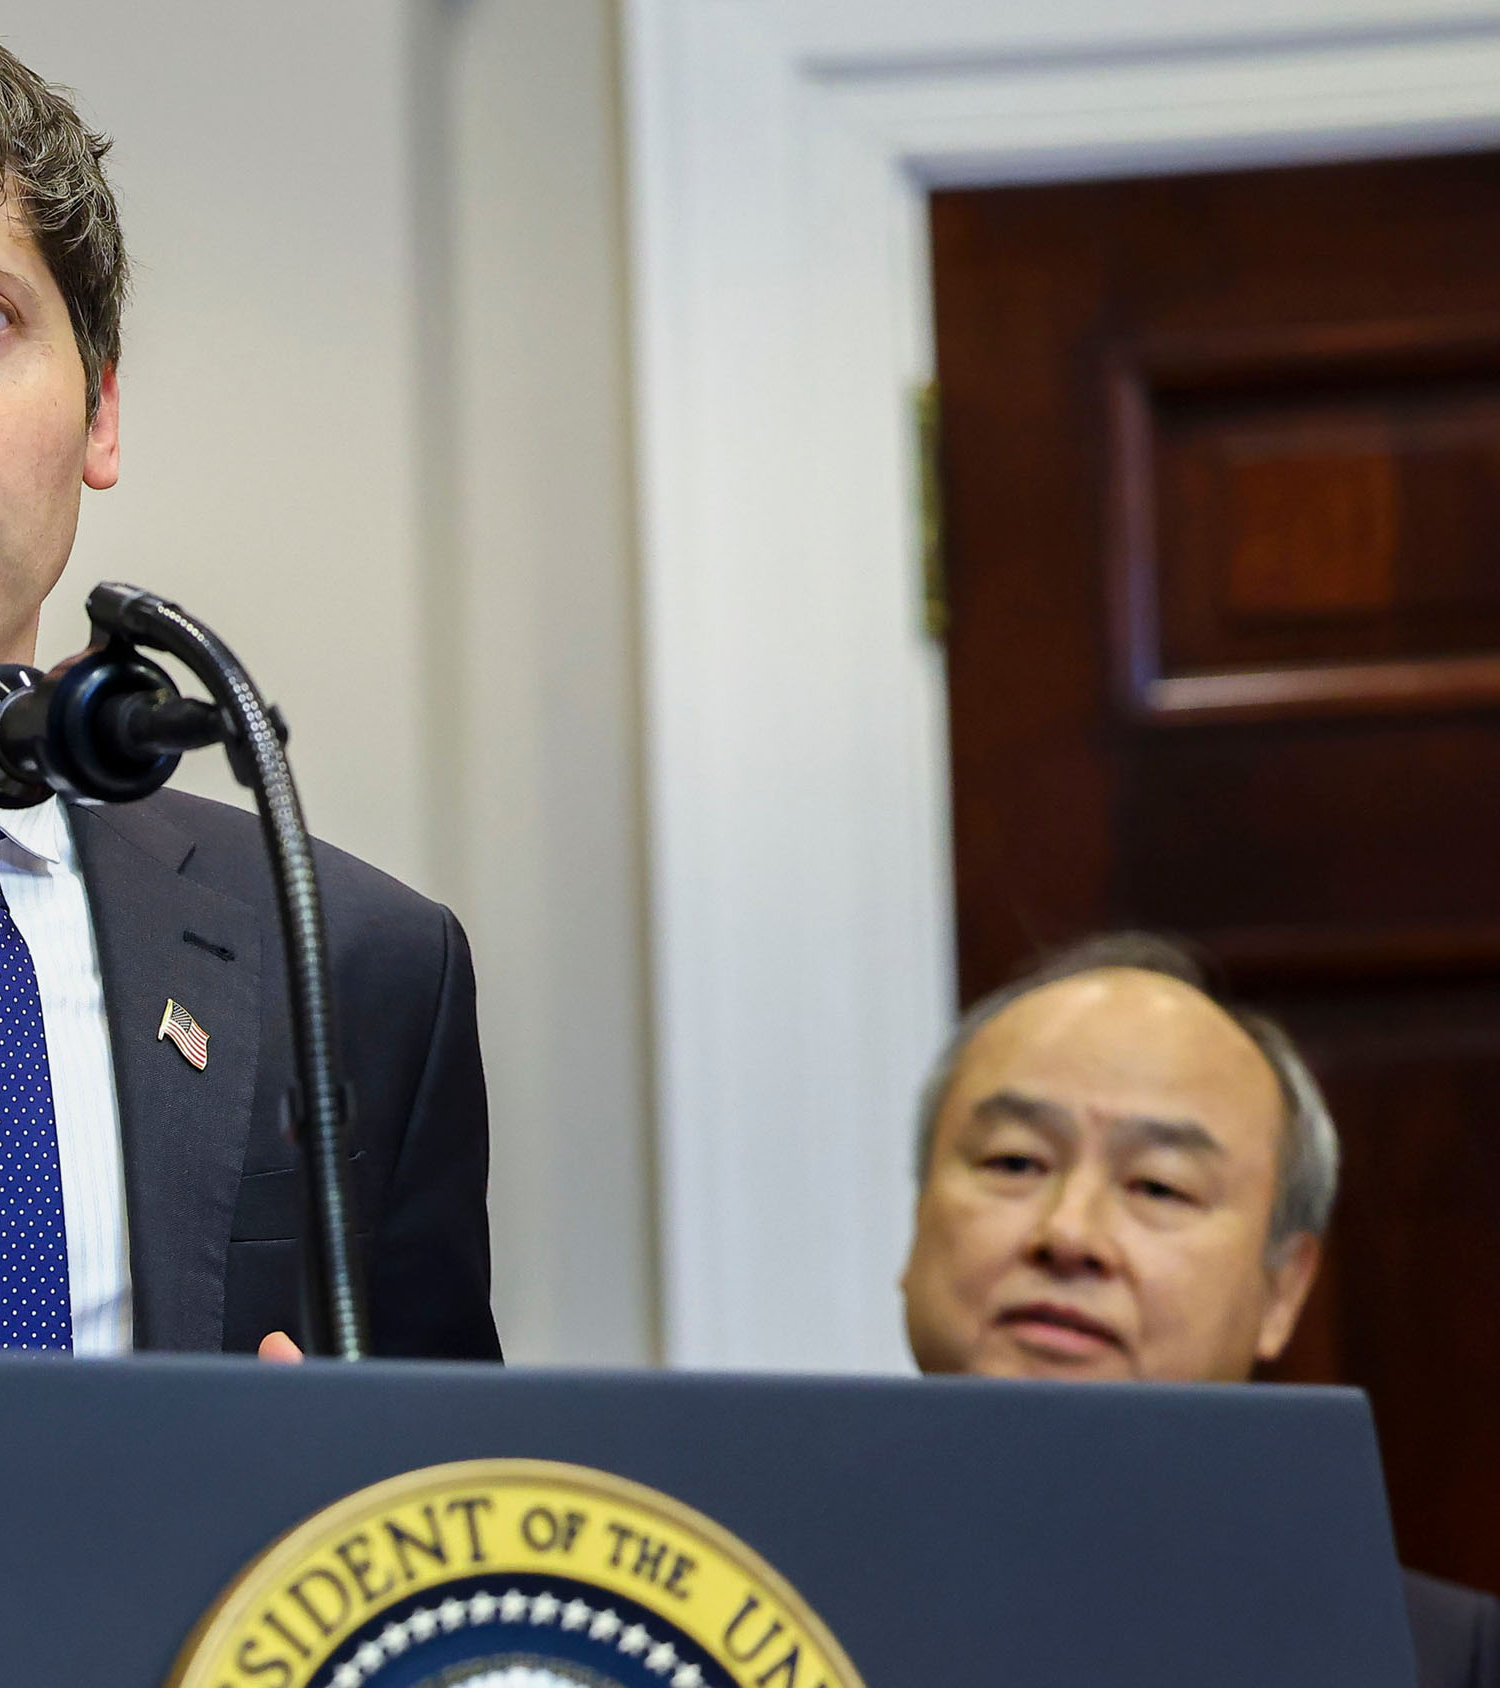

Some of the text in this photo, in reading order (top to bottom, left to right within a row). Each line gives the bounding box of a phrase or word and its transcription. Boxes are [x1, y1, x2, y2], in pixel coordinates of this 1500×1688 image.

[219, 1496, 495, 1688] SIDENT
[521, 1506, 587, 1552] OF
[606, 1521, 698, 1599] THE
